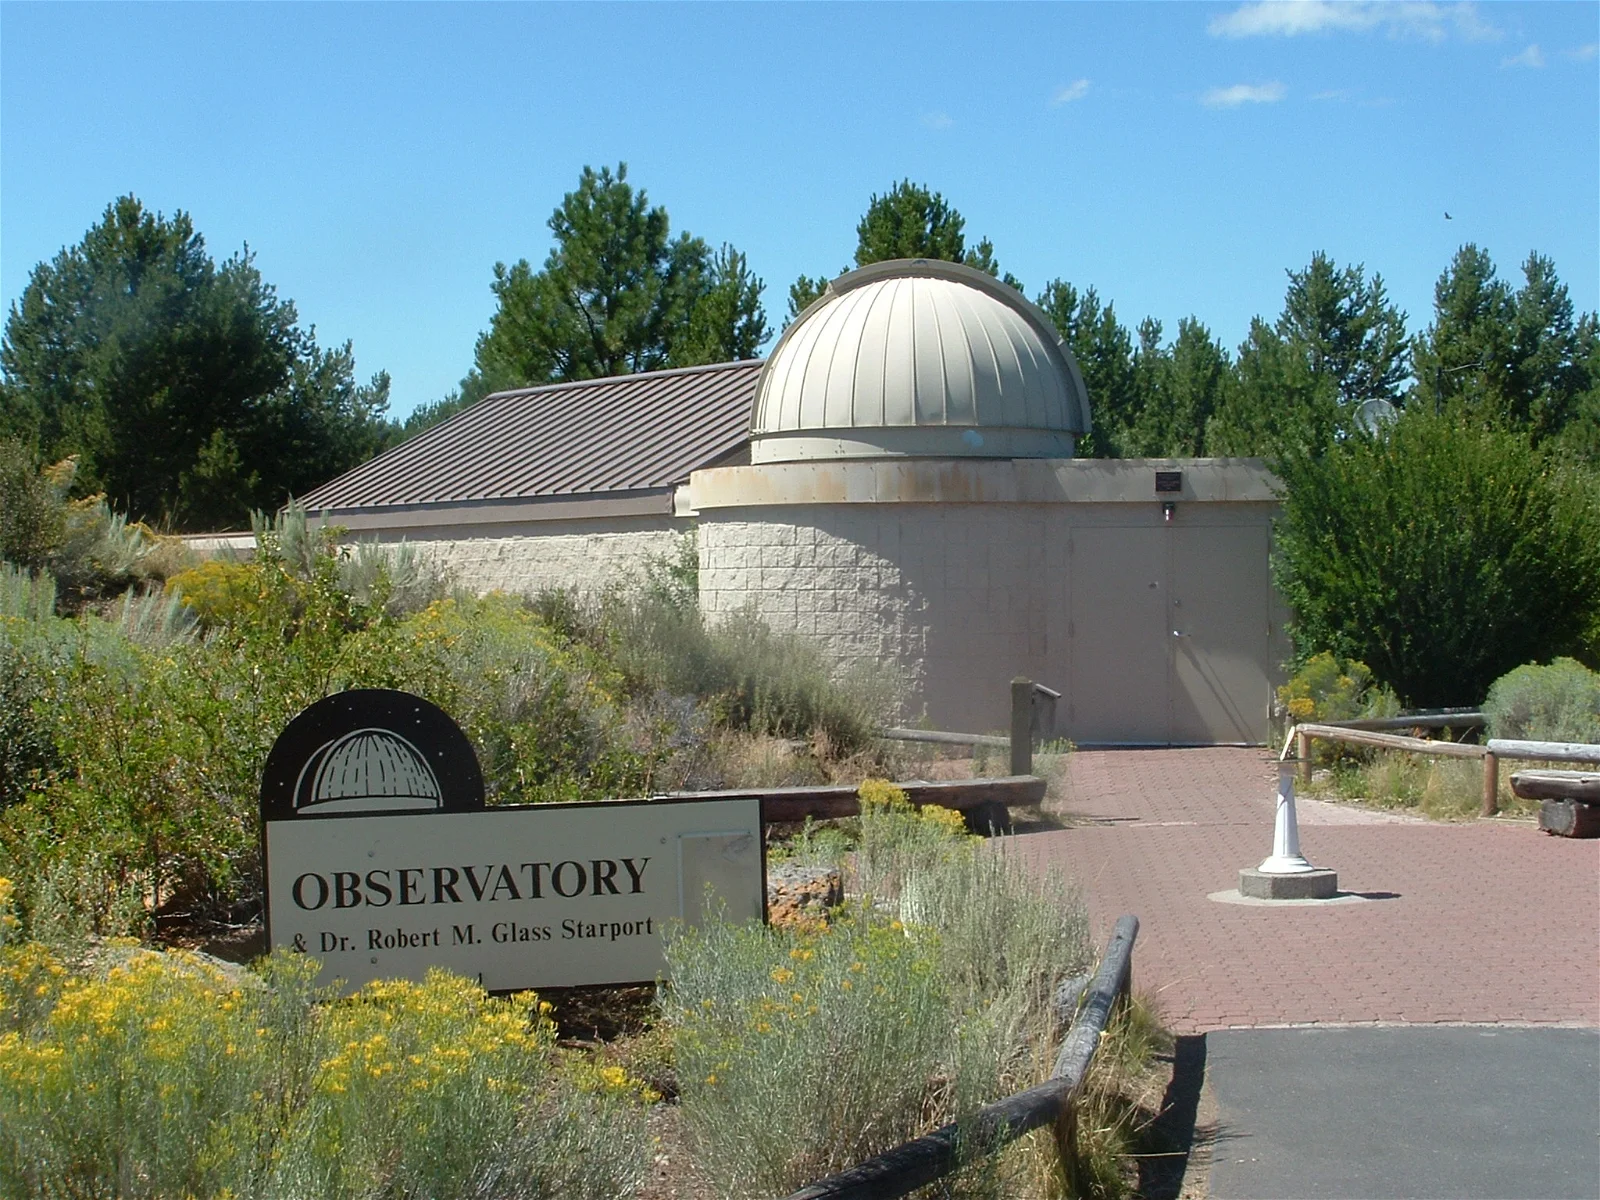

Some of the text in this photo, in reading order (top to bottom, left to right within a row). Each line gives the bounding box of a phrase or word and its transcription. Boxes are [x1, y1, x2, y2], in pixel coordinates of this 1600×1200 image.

[291, 857, 652, 911] OBSERVATORY
[291, 916, 654, 953] & Dr. Robert M. Glass Starport
